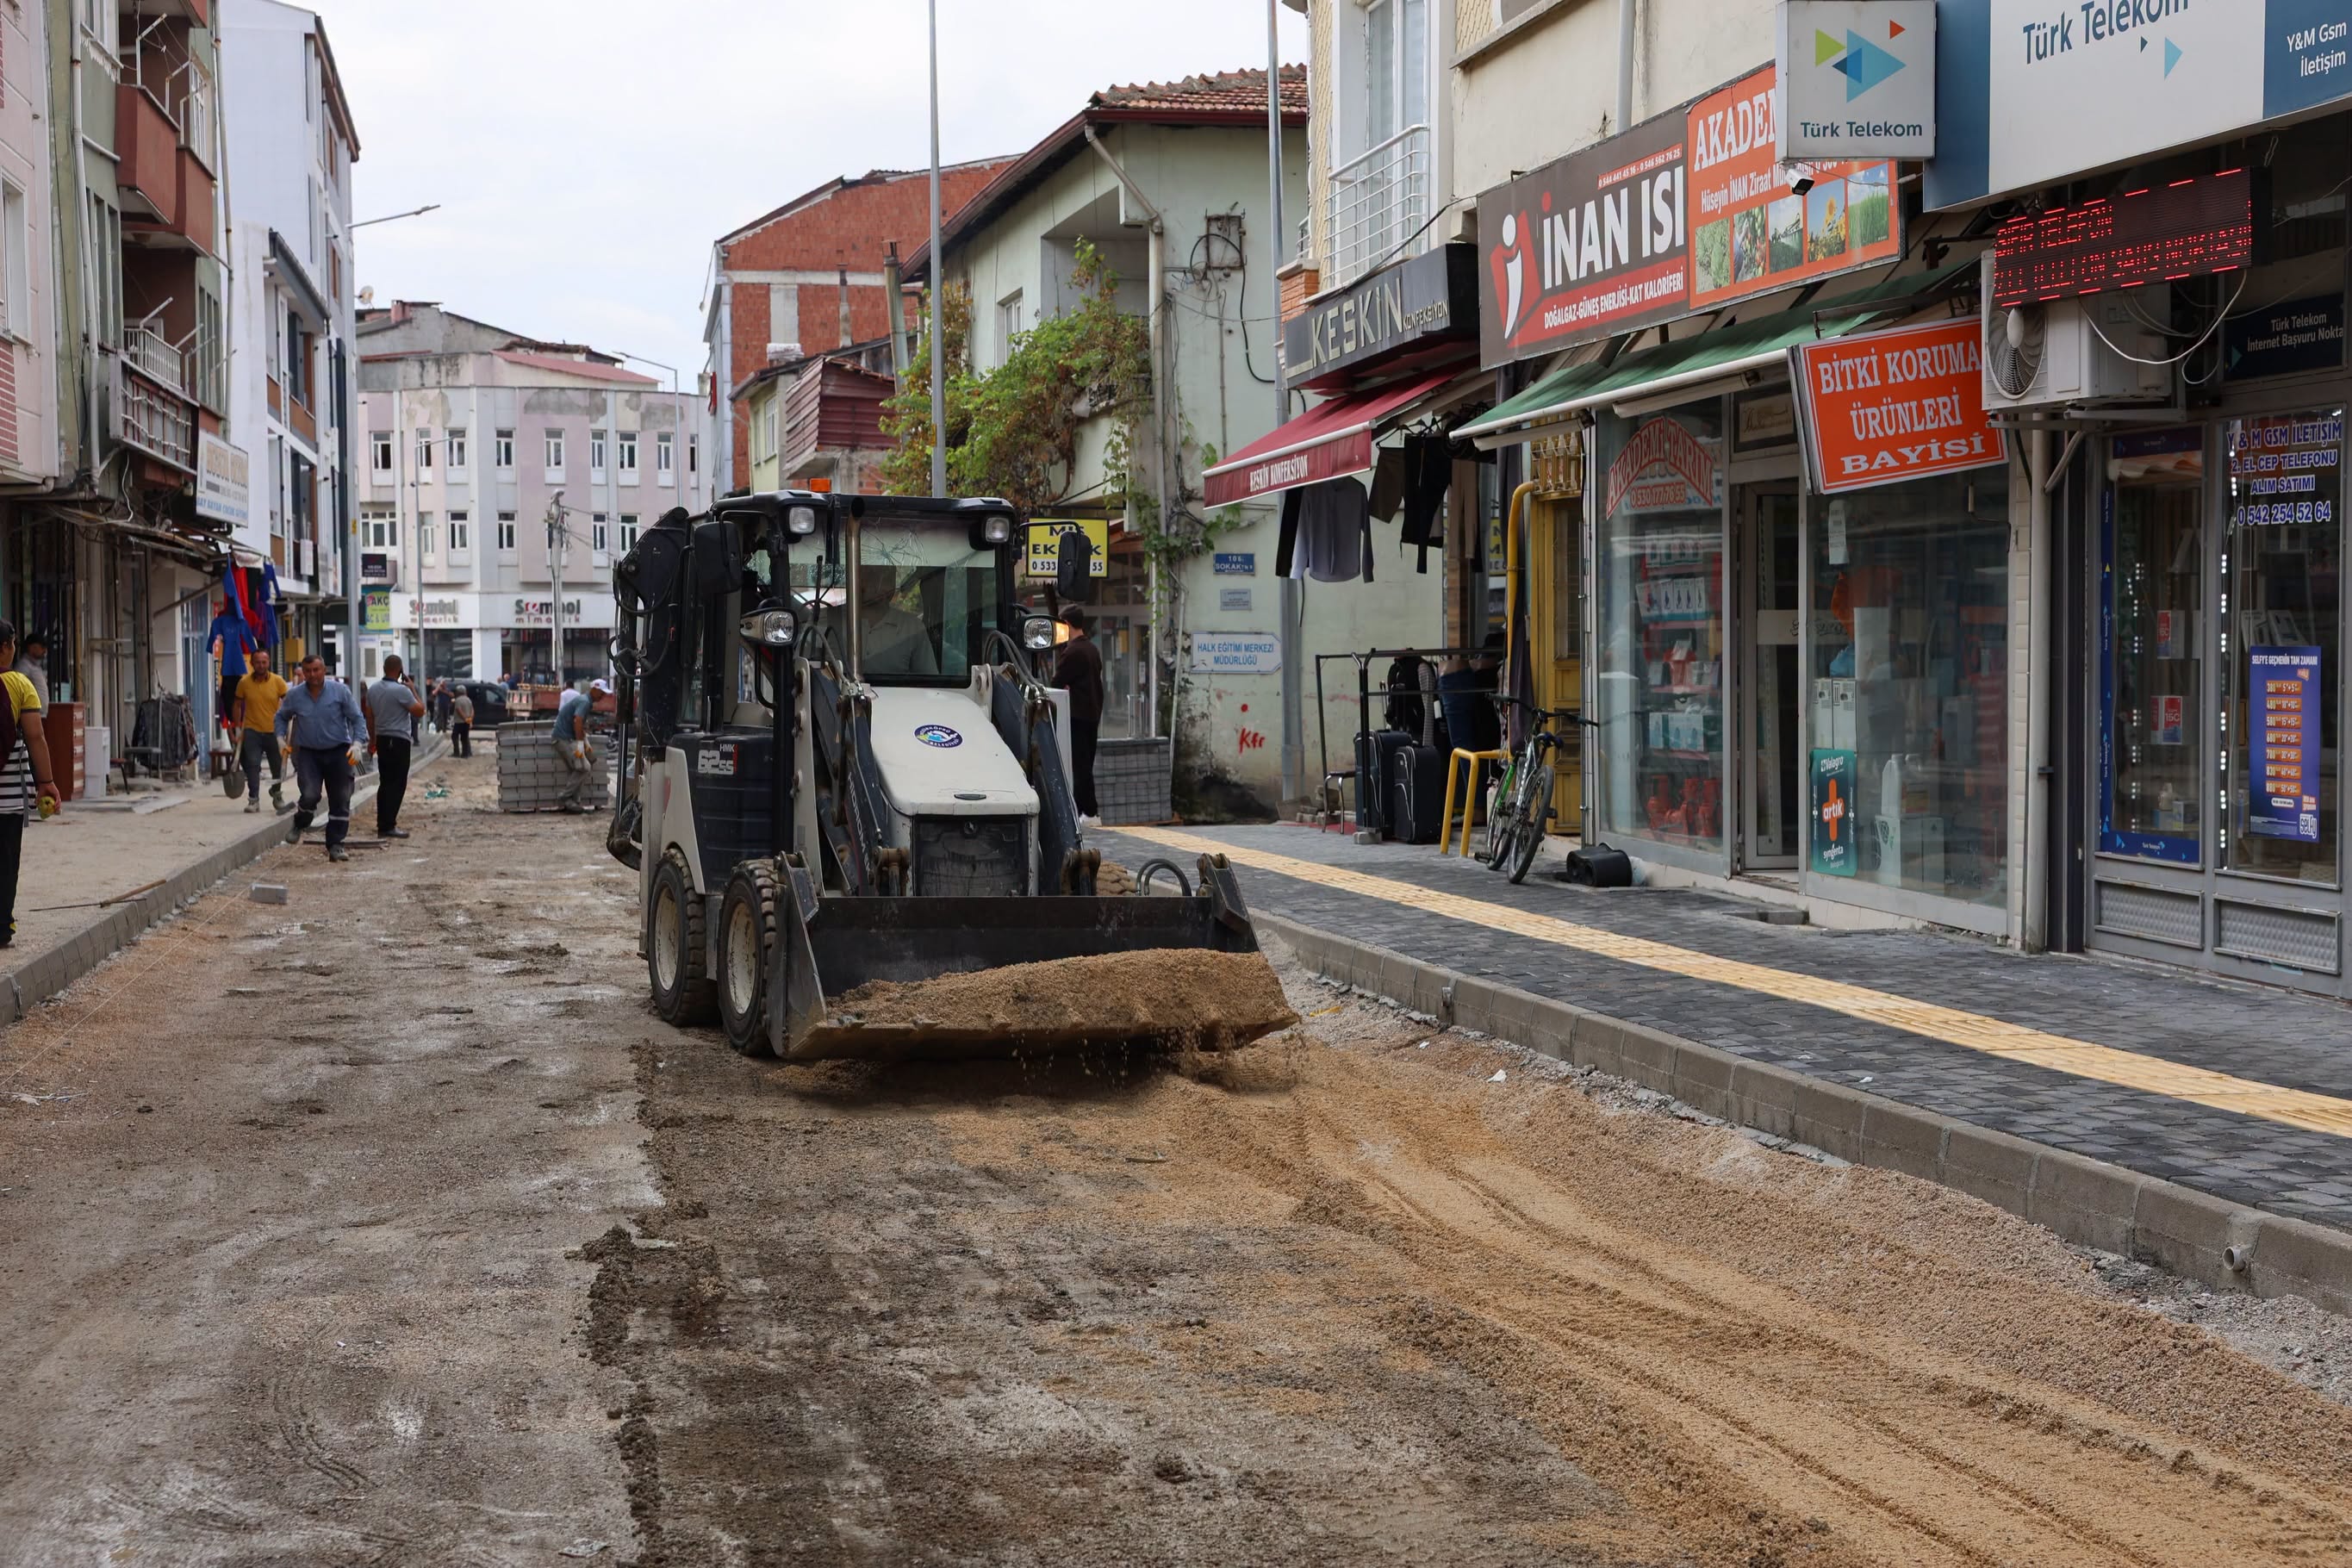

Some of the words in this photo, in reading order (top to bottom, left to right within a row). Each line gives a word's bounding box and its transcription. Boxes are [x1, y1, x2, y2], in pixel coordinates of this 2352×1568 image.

[2023, 10, 2074, 65] Türk
[2287, 28, 2316, 53] Y&M
[2319, 20, 2348, 43] Gsm
[2299, 49, 2346, 78] İletişim
[1800, 121, 1840, 138] Türk
[1845, 121, 1923, 137] Telekom
[1602, 177, 1613, 186] 544
[1622, 169, 1629, 177] 45
[1673, 148, 1680, 158] 25
[1701, 184, 1728, 215] Hüseyin
[1730, 175, 1748, 203] İNAN
[1749, 166, 1771, 196] Ziraat
[1543, 187, 1629, 289] İNAN
[1640, 165, 1685, 258] ISI
[1544, 296, 1600, 330] DOĞALGAZ-GÜNEŞ
[1600, 283, 1643, 314] ENERJİSİ-KAT
[1644, 265, 1683, 301] KALORİFERİ
[1403, 299, 1449, 332] KONFEKSİYON
[2271, 317, 2290, 332] Türk
[2291, 312, 2327, 328] Telekom
[2247, 336, 2280, 352] İnternet
[2281, 333, 2316, 348] Başvuru
[1818, 346, 1882, 395] BİTKİ
[1884, 339, 1982, 384] KORUMA
[1850, 386, 1963, 441] ÜRÜNLERİ
[2227, 432, 2235, 450] Y
[2238, 432, 2248, 449] &
[2250, 429, 2262, 448] M
[2265, 426, 2289, 447] GSM
[2292, 417, 2343, 447] İLETİŞİM
[1607, 416, 1665, 520] AKADEMİ
[1667, 417, 1714, 507] TARIM
[1840, 432, 1986, 475] BAYİSİ
[2231, 457, 2242, 473] 2.
[2243, 457, 2256, 471] EL
[2258, 455, 2279, 470] CEP
[2280, 449, 2337, 469] TELEFONU
[1249, 464, 1269, 493] KESKİN
[1270, 454, 1309, 486] KONFEKSİYON
[2250, 477, 2277, 495] ALIM
[2279, 475, 2316, 493] SATIMI
[2237, 506, 2246, 526] 0
[2248, 503, 2270, 526] 542
[2271, 502, 2294, 524] 254
[2297, 501, 2313, 523] 52
[2315, 501, 2330, 522] 64
[1032, 544, 1102, 556] EKK
[1032, 561, 1037, 570] 0
[1040, 561, 1056, 570] 533
[1092, 562, 1103, 571] 55
[515, 614, 580, 624] mimalık
[1198, 642, 1216, 652] HALK
[1217, 641, 1242, 652] EĞİTİMİ
[1243, 642, 1274, 652] MERKEZİ
[1213, 654, 1258, 665] MÜDÜRLÜĞÜ
[719, 744, 735, 752] HMK
[1823, 843, 1844, 862] syngenta
